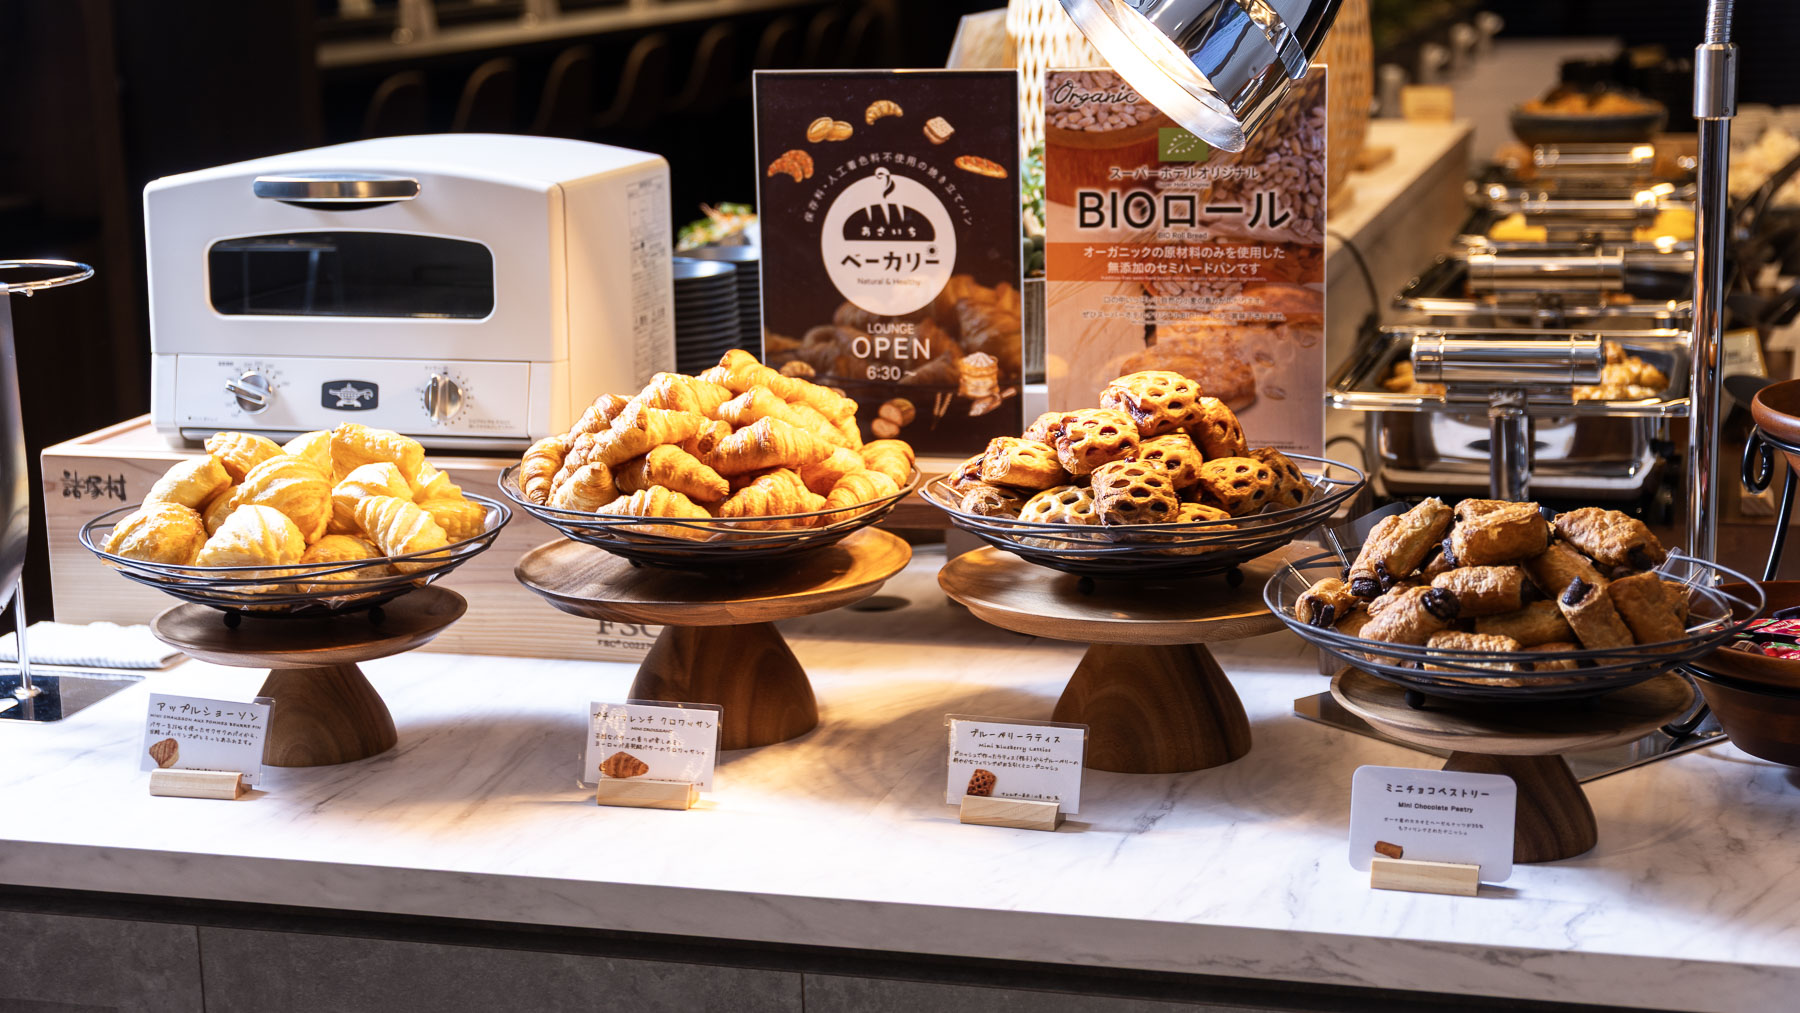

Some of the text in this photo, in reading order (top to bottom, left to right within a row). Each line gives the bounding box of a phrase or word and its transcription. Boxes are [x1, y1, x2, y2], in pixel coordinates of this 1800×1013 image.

[1054, 79, 1139, 108] Organic
[1109, 166, 1259, 182] スーパーホテルオリジナル
[803, 152, 973, 226] 保存料・人工着色料不使用の焼き立てパン
[1078, 191, 1291, 229] BIOロール
[861, 226, 917, 237] あさいち
[1083, 246, 1286, 260] オーガニックの原材料のみを使用した
[841, 251, 940, 272] ベーカリー
[1107, 261, 1261, 275] 無添加のセミハードパンです
[857, 278, 883, 286] Natural
[893, 278, 920, 287] Healthy
[867, 323, 915, 335] LOUNGE
[851, 336, 931, 360] OPEN
[157, 702, 259, 721] アップルショーソン
[971, 728, 1061, 744] ブルーベリーラティス
[1414, 803, 1448, 812] Chocolate
[1451, 805, 1473, 814] Pastry
